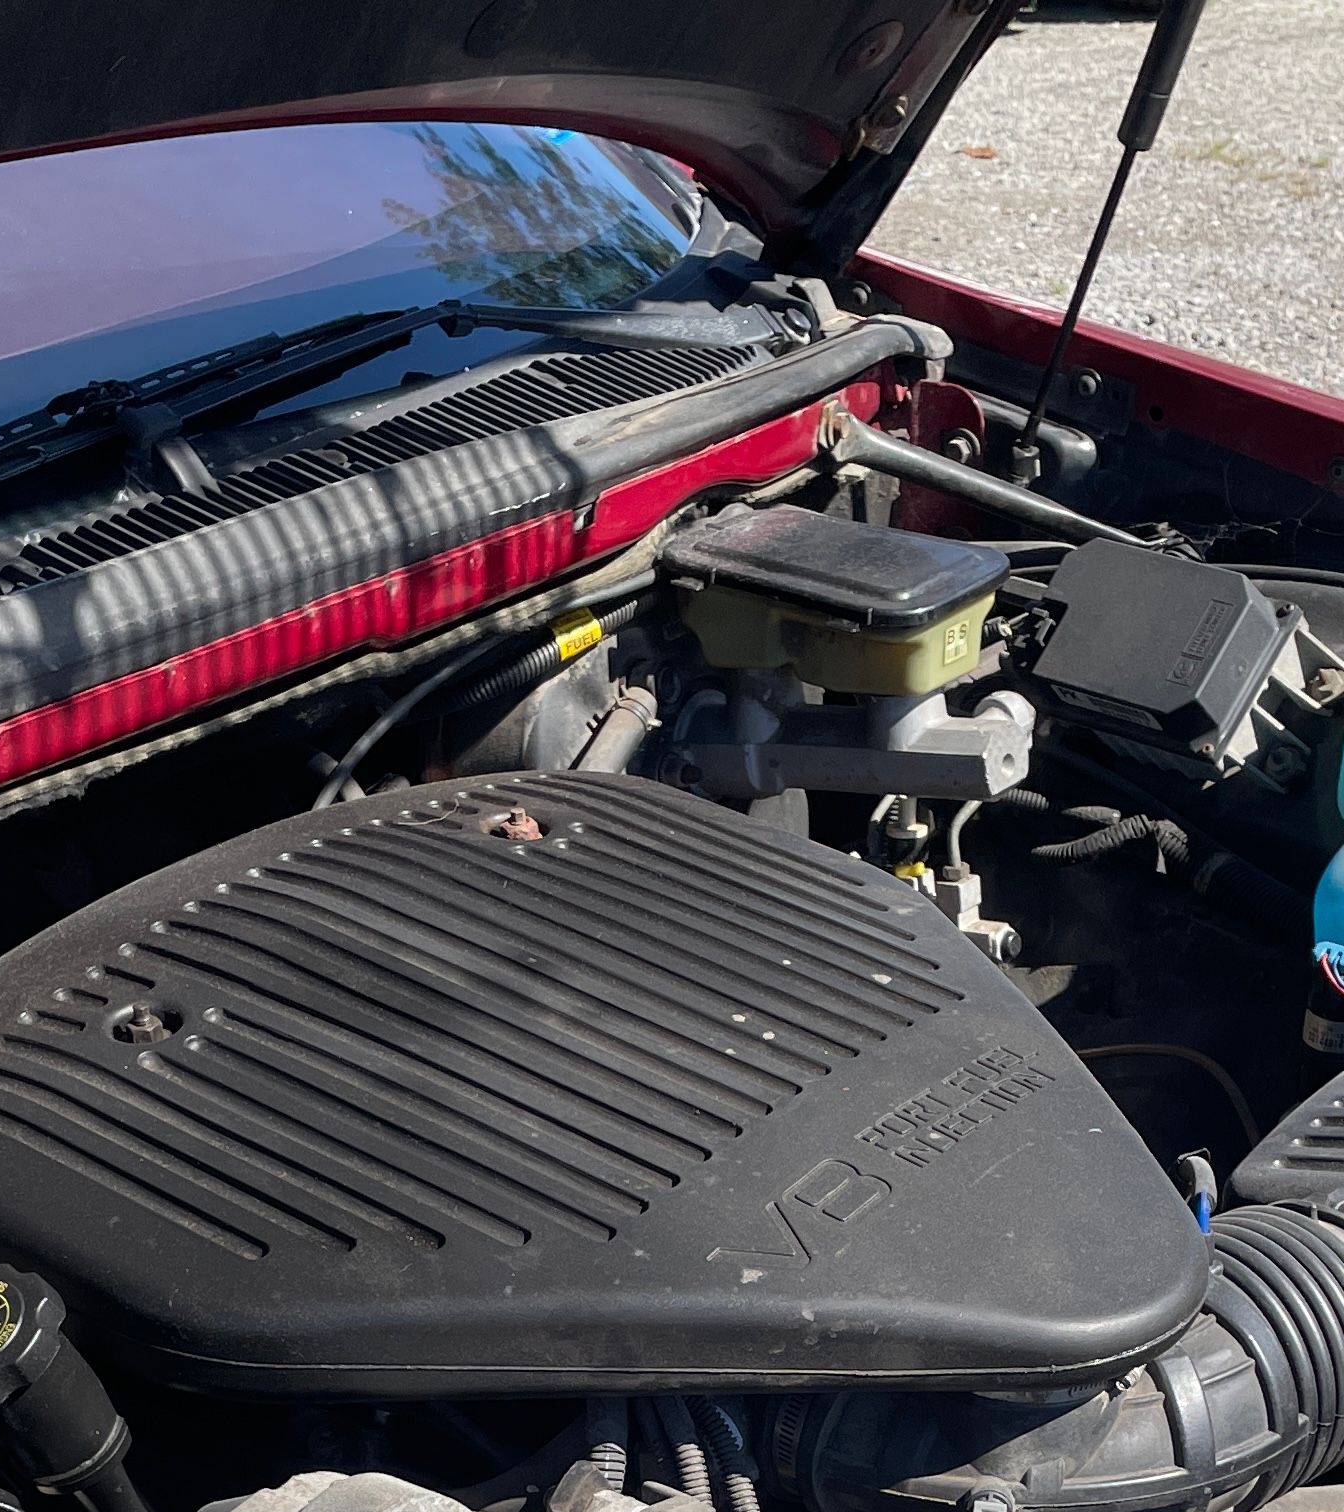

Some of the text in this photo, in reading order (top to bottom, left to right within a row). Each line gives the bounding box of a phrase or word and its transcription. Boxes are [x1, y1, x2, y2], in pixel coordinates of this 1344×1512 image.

[564, 629, 599, 654] FUEL
[855, 1046, 1040, 1151] PORT FUEL
[891, 1066, 1059, 1167] INJECTION
[706, 1158, 892, 1266] V8
